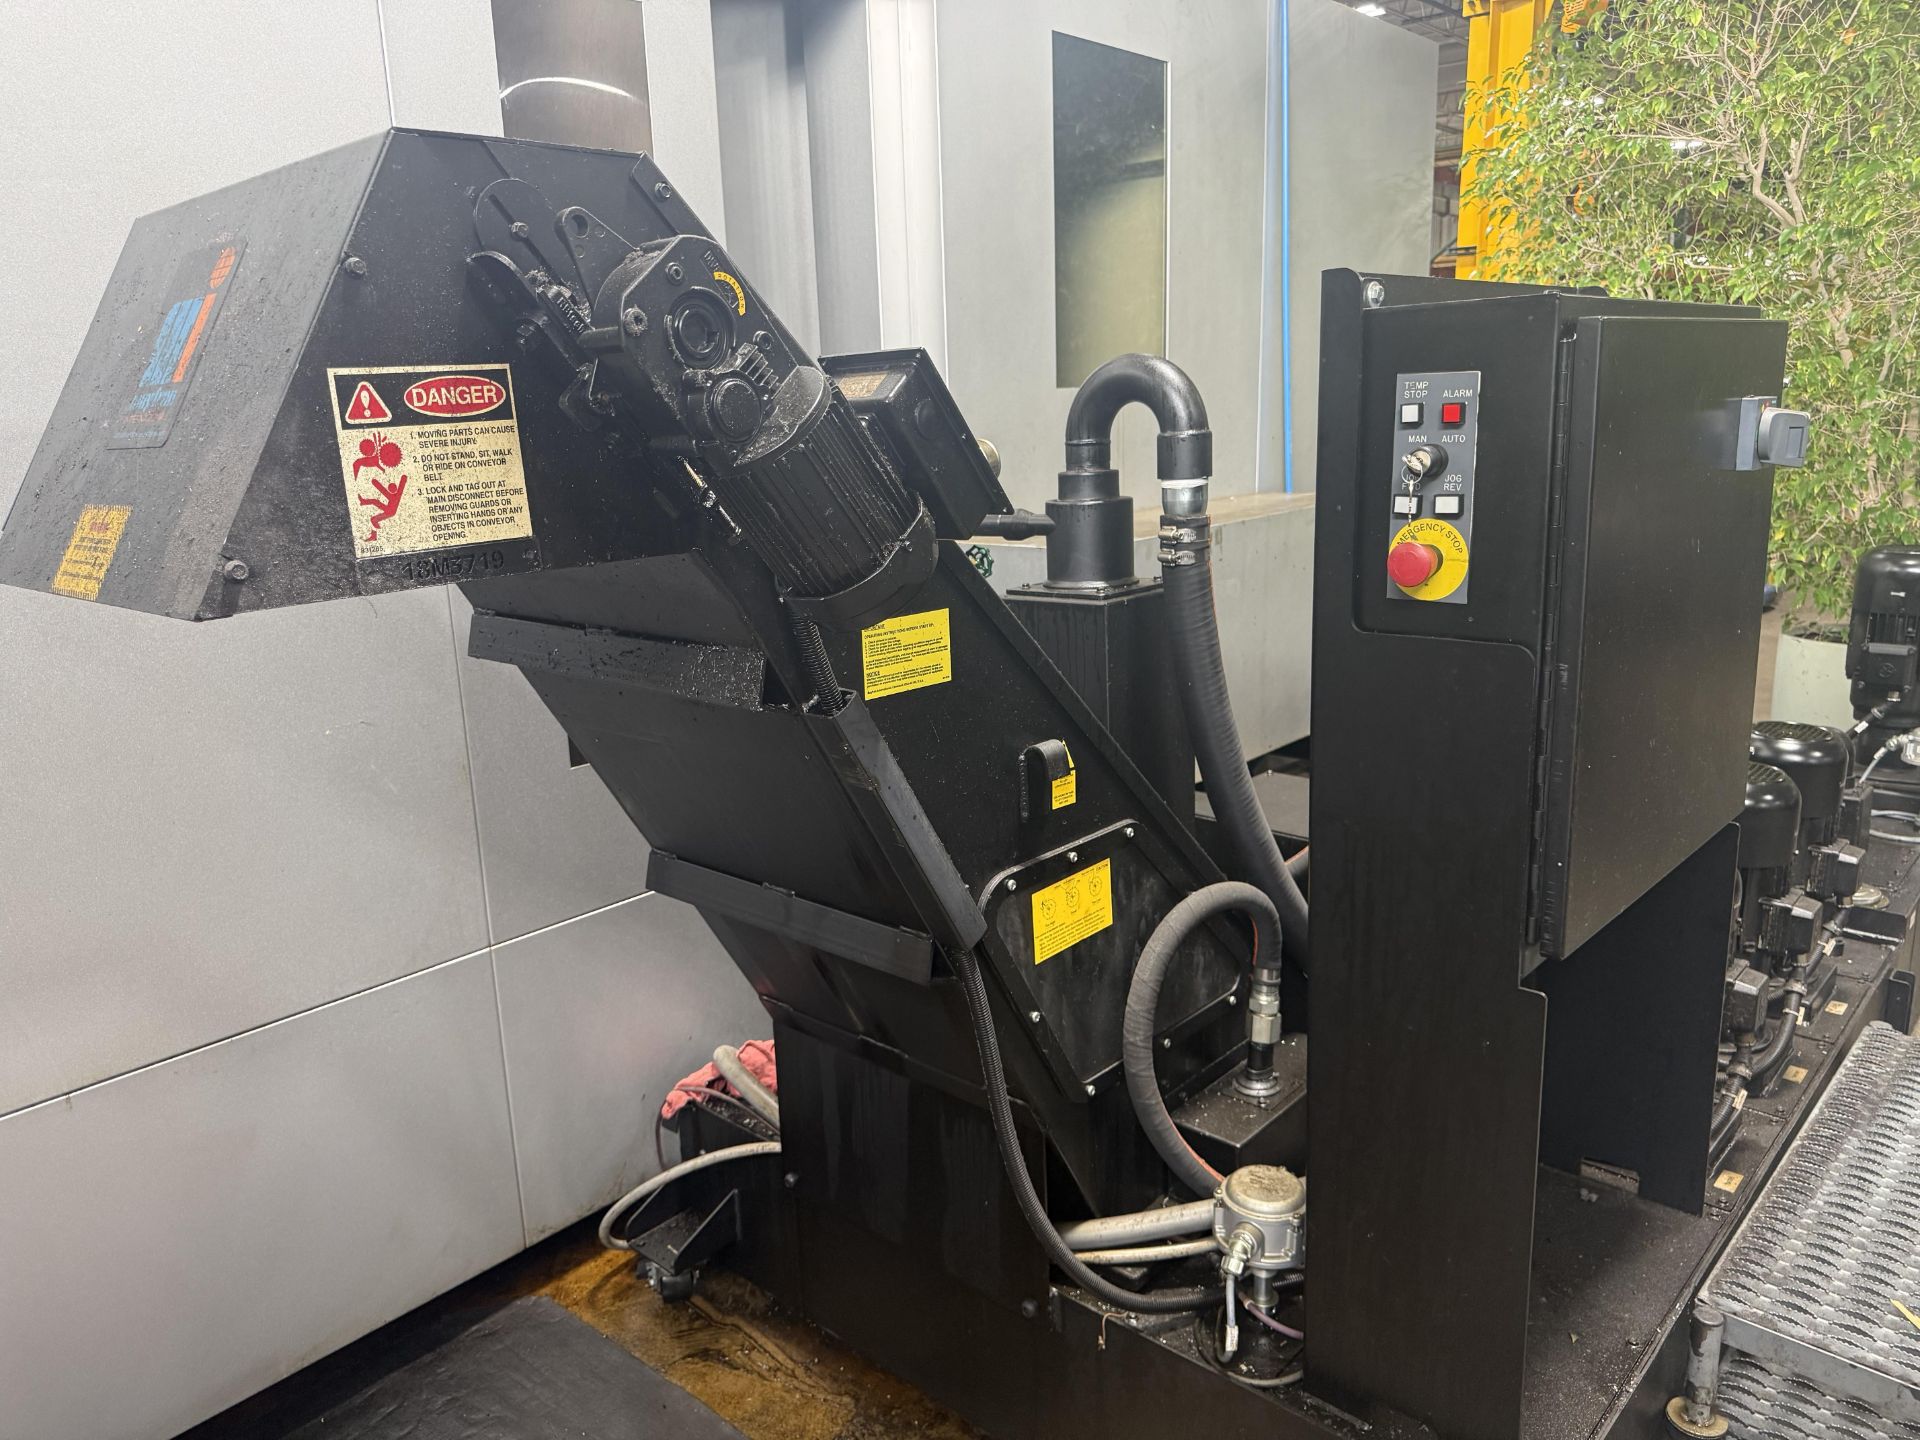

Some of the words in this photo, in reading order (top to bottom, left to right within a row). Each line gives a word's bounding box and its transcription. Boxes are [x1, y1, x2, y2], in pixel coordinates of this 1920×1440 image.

[717, 273, 745, 309] ROTATION
[1404, 381, 1429, 390] TEMP
[411, 385, 498, 407] DANGER
[1403, 390, 1428, 399] STOP
[1442, 389, 1473, 398] ALARM
[417, 429, 448, 439] MOVING
[449, 427, 473, 437] PARTS
[474, 426, 490, 435] CAN
[490, 425, 515, 434] CAUSE
[1408, 435, 1427, 443] MAN
[1441, 434, 1466, 443] AUTO
[419, 439, 449, 449] SEVERE
[412, 455, 420, 463] 2.
[420, 454, 433, 463] DO
[434, 453, 450, 461] NOT
[451, 451, 478, 460] STAND,
[478, 450, 491, 458] SIT,
[491, 448, 513, 457] WALK
[422, 464, 434, 472] OR
[435, 463, 453, 471] RIDE
[454, 461, 466, 469] ON
[466, 459, 507, 468] CONVEYOR
[1444, 474, 1462, 483] JOG
[417, 488, 425, 496] 3.
[425, 486, 447, 495] LOCK
[448, 484, 464, 493] AND
[465, 483, 480, 491] TAG
[481, 481, 496, 489] OUT
[497, 480, 507, 488] AT
[1401, 482, 1421, 491] FD
[1443, 483, 1463, 491] REV
[427, 495, 446, 504] MAIN
[447, 490, 495, 502] DISCONNECT
[495, 488, 524, 497] BEFORE
[428, 503, 468, 514] REMOVING
[469, 500, 500, 510] GUARDS
[501, 498, 512, 506] OR
[430, 511, 470, 523] INSERTING
[470, 509, 496, 518] HANDS
[497, 507, 508, 515] OR
[508, 506, 523, 514] ANY
[431, 521, 466, 532] OBJECTS
[466, 520, 475, 528] IN
[475, 516, 516, 527] CONVEYOR
[1397, 523, 1446, 545] MERGENCY
[1445, 530, 1464, 554] STOP
